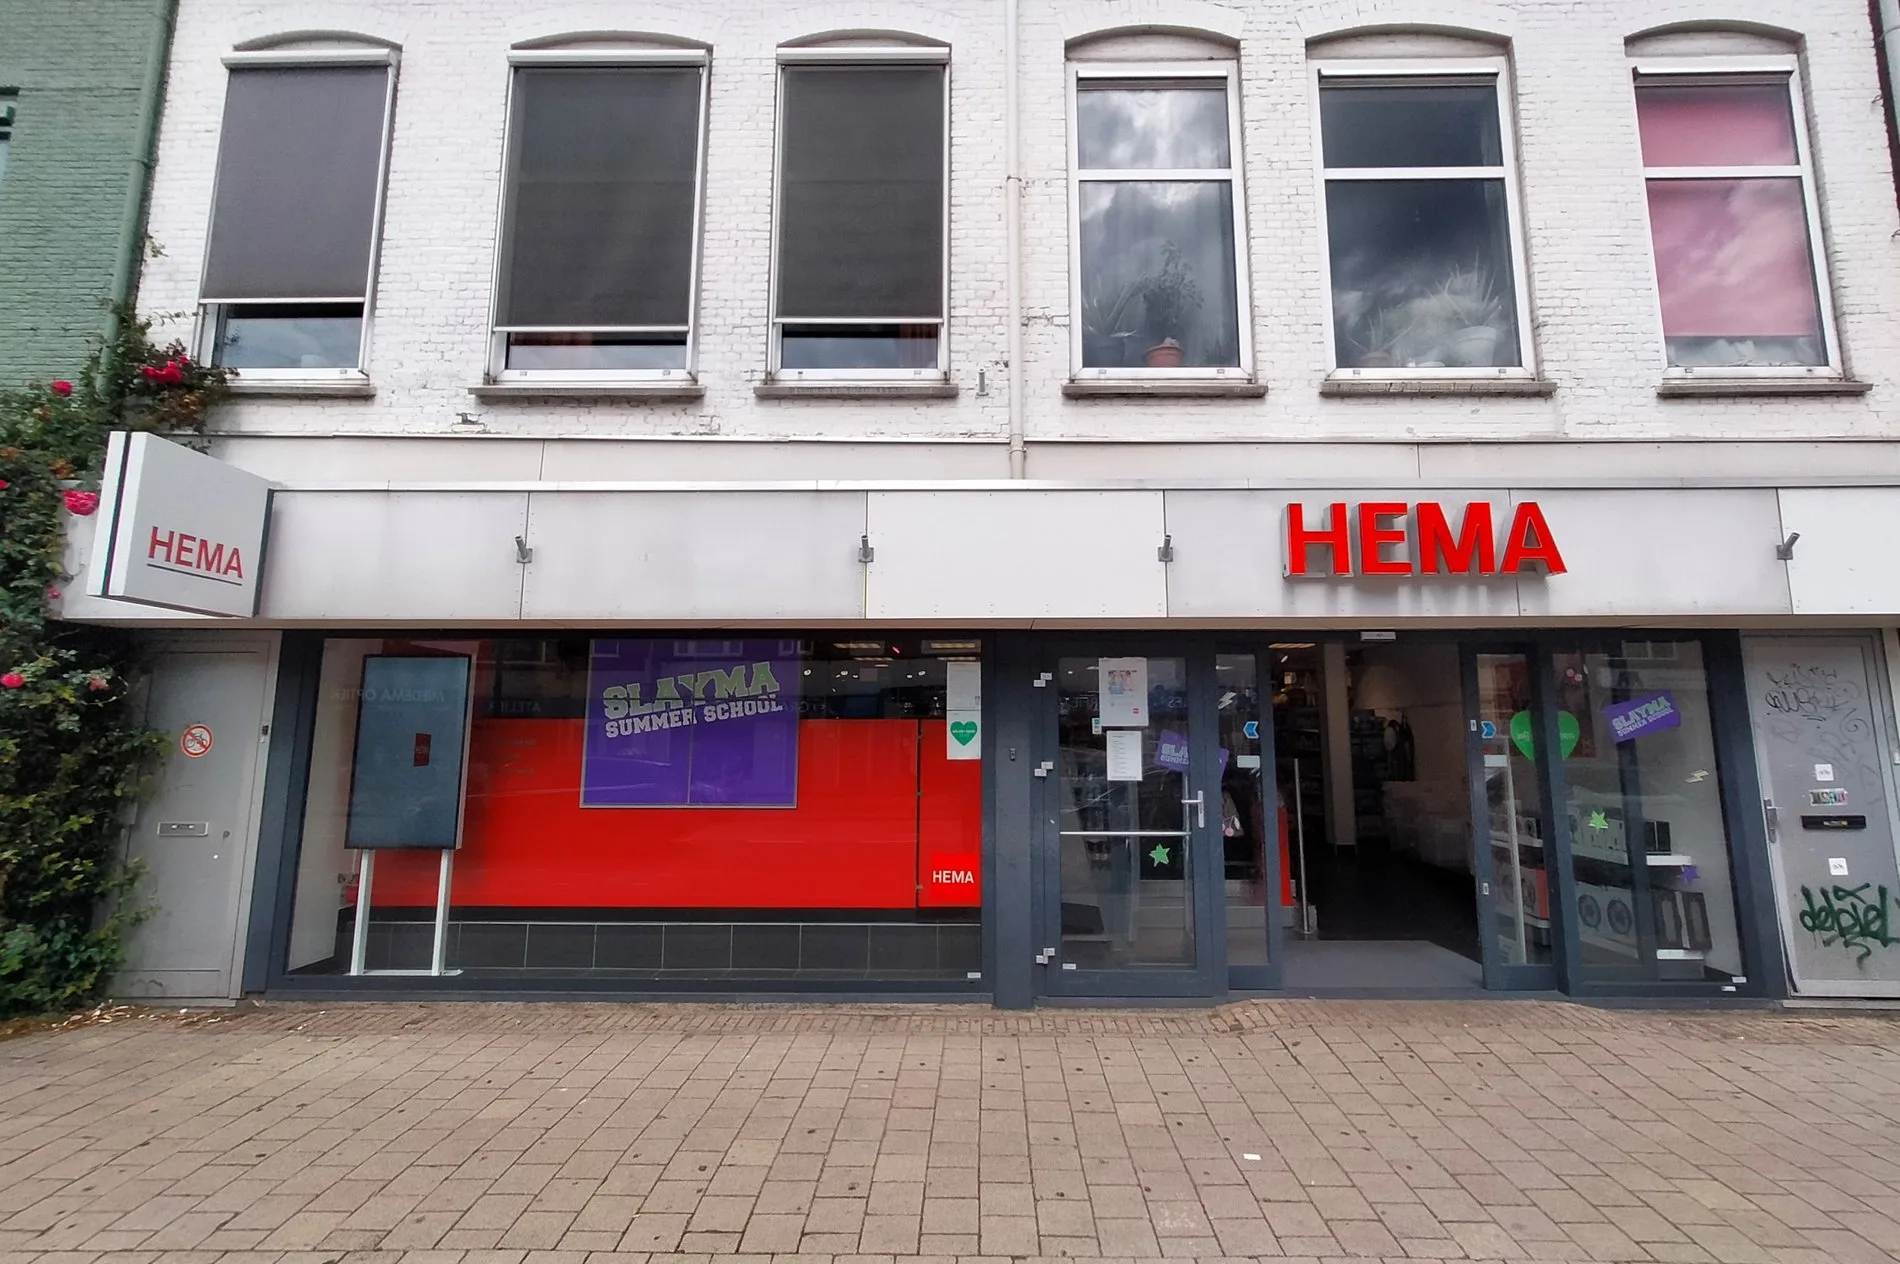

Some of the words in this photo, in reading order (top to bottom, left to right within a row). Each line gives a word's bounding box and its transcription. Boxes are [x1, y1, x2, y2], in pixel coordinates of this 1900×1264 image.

[148, 525, 243, 579] HEMA
[1285, 501, 1568, 576] HEMA
[602, 661, 781, 720] SLAYMA
[605, 708, 698, 738] SUMMER
[703, 694, 783, 722] SCHOOL
[932, 870, 974, 884] HEMA
